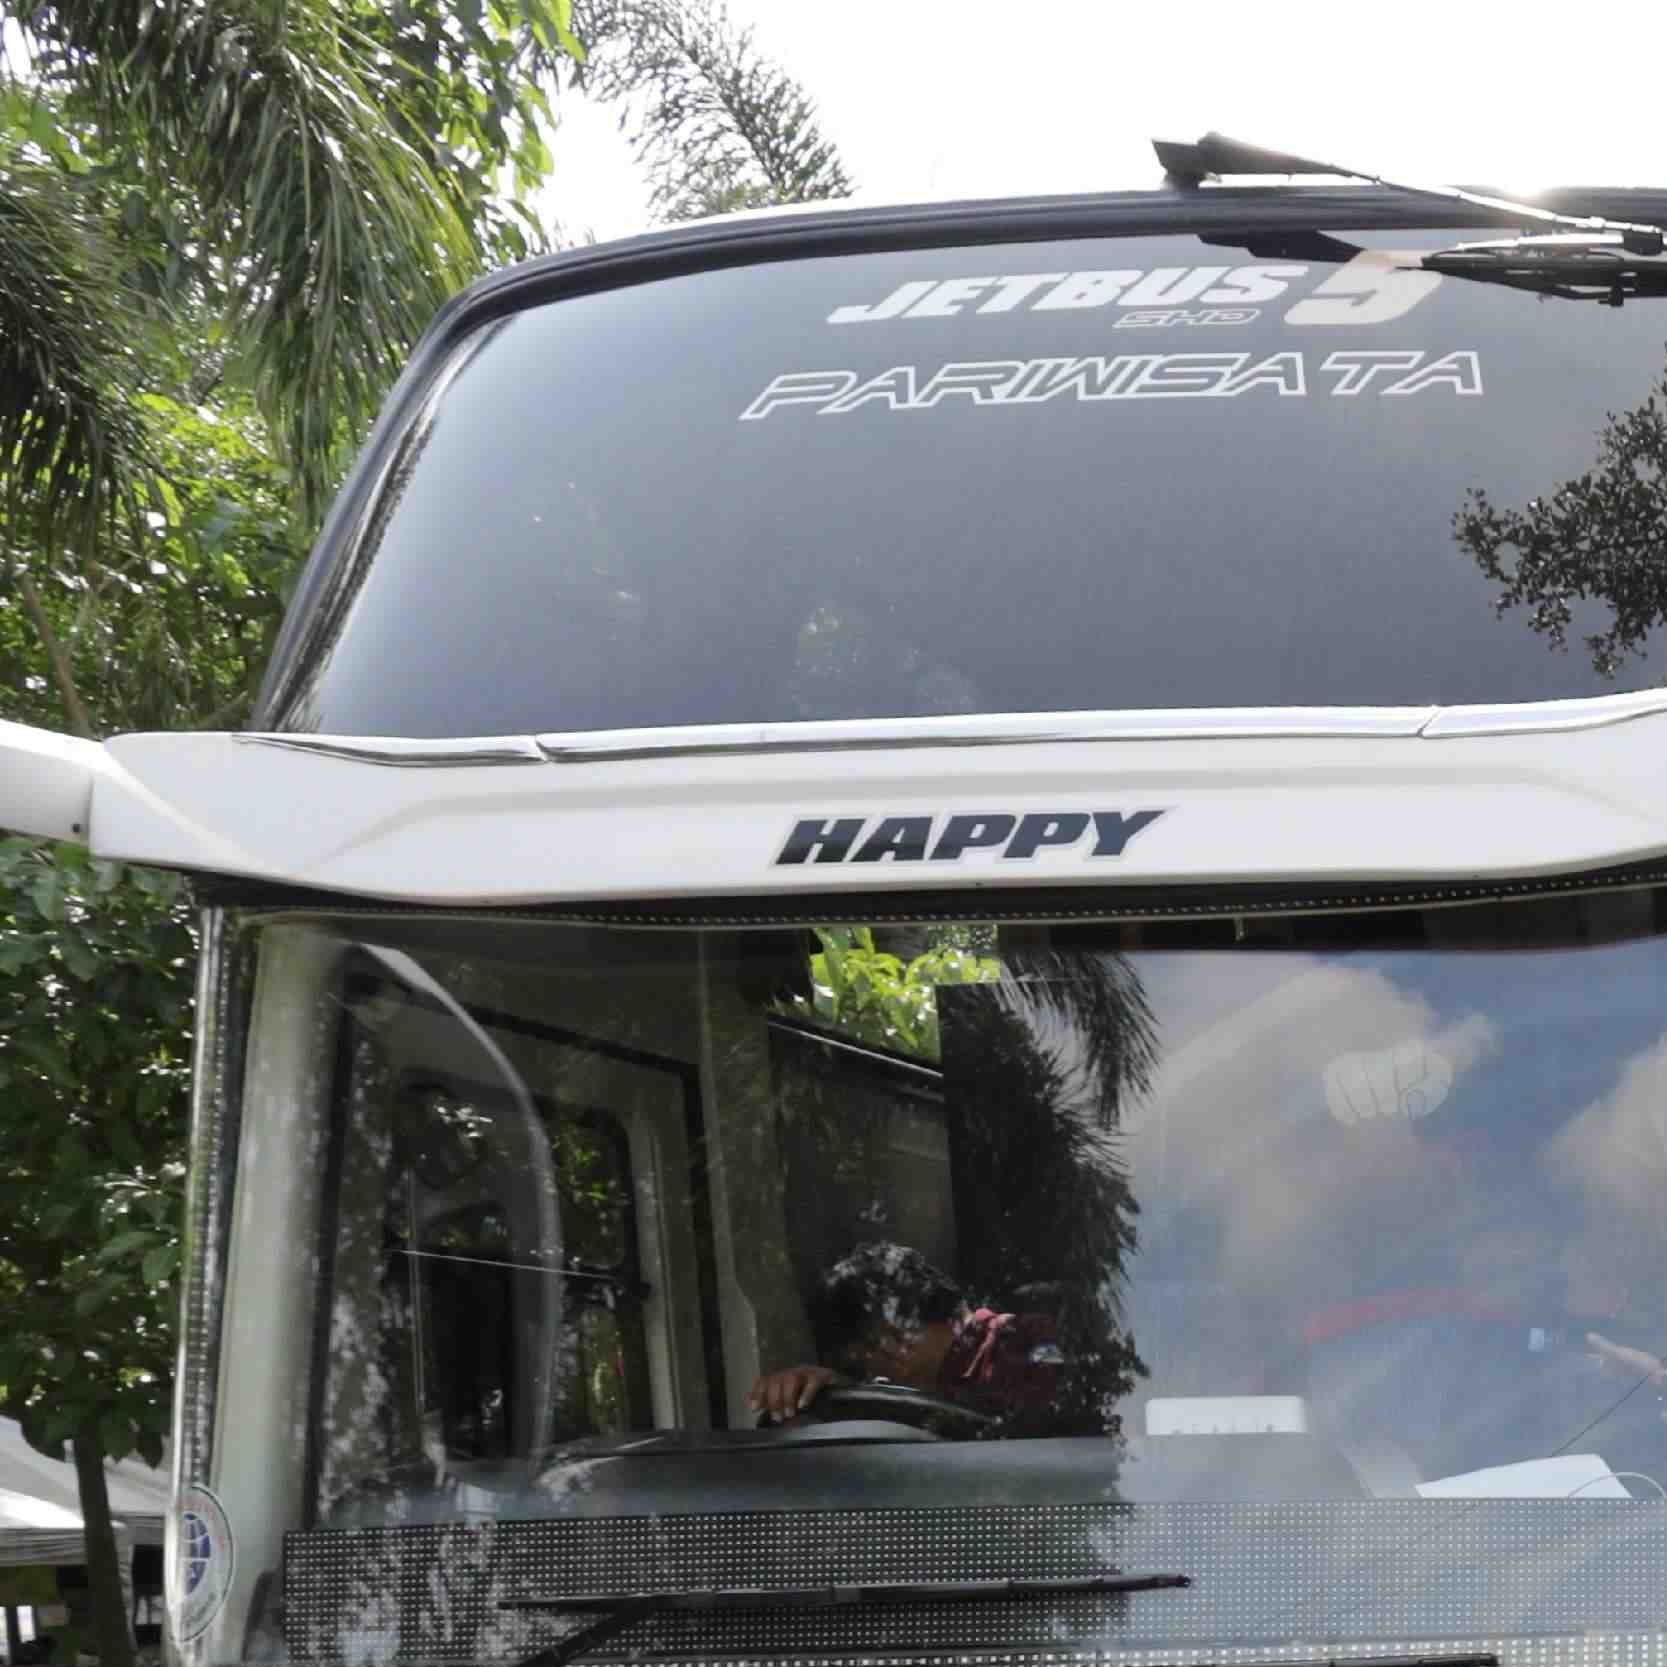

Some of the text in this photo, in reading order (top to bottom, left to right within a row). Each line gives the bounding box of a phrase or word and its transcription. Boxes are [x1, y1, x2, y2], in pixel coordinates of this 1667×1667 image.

[826, 264, 1310, 324] JETBUS
[1112, 308, 1261, 328] SHD
[739, 350, 1484, 421] PARIWISATA
[774, 809, 1167, 866] HAPPY
